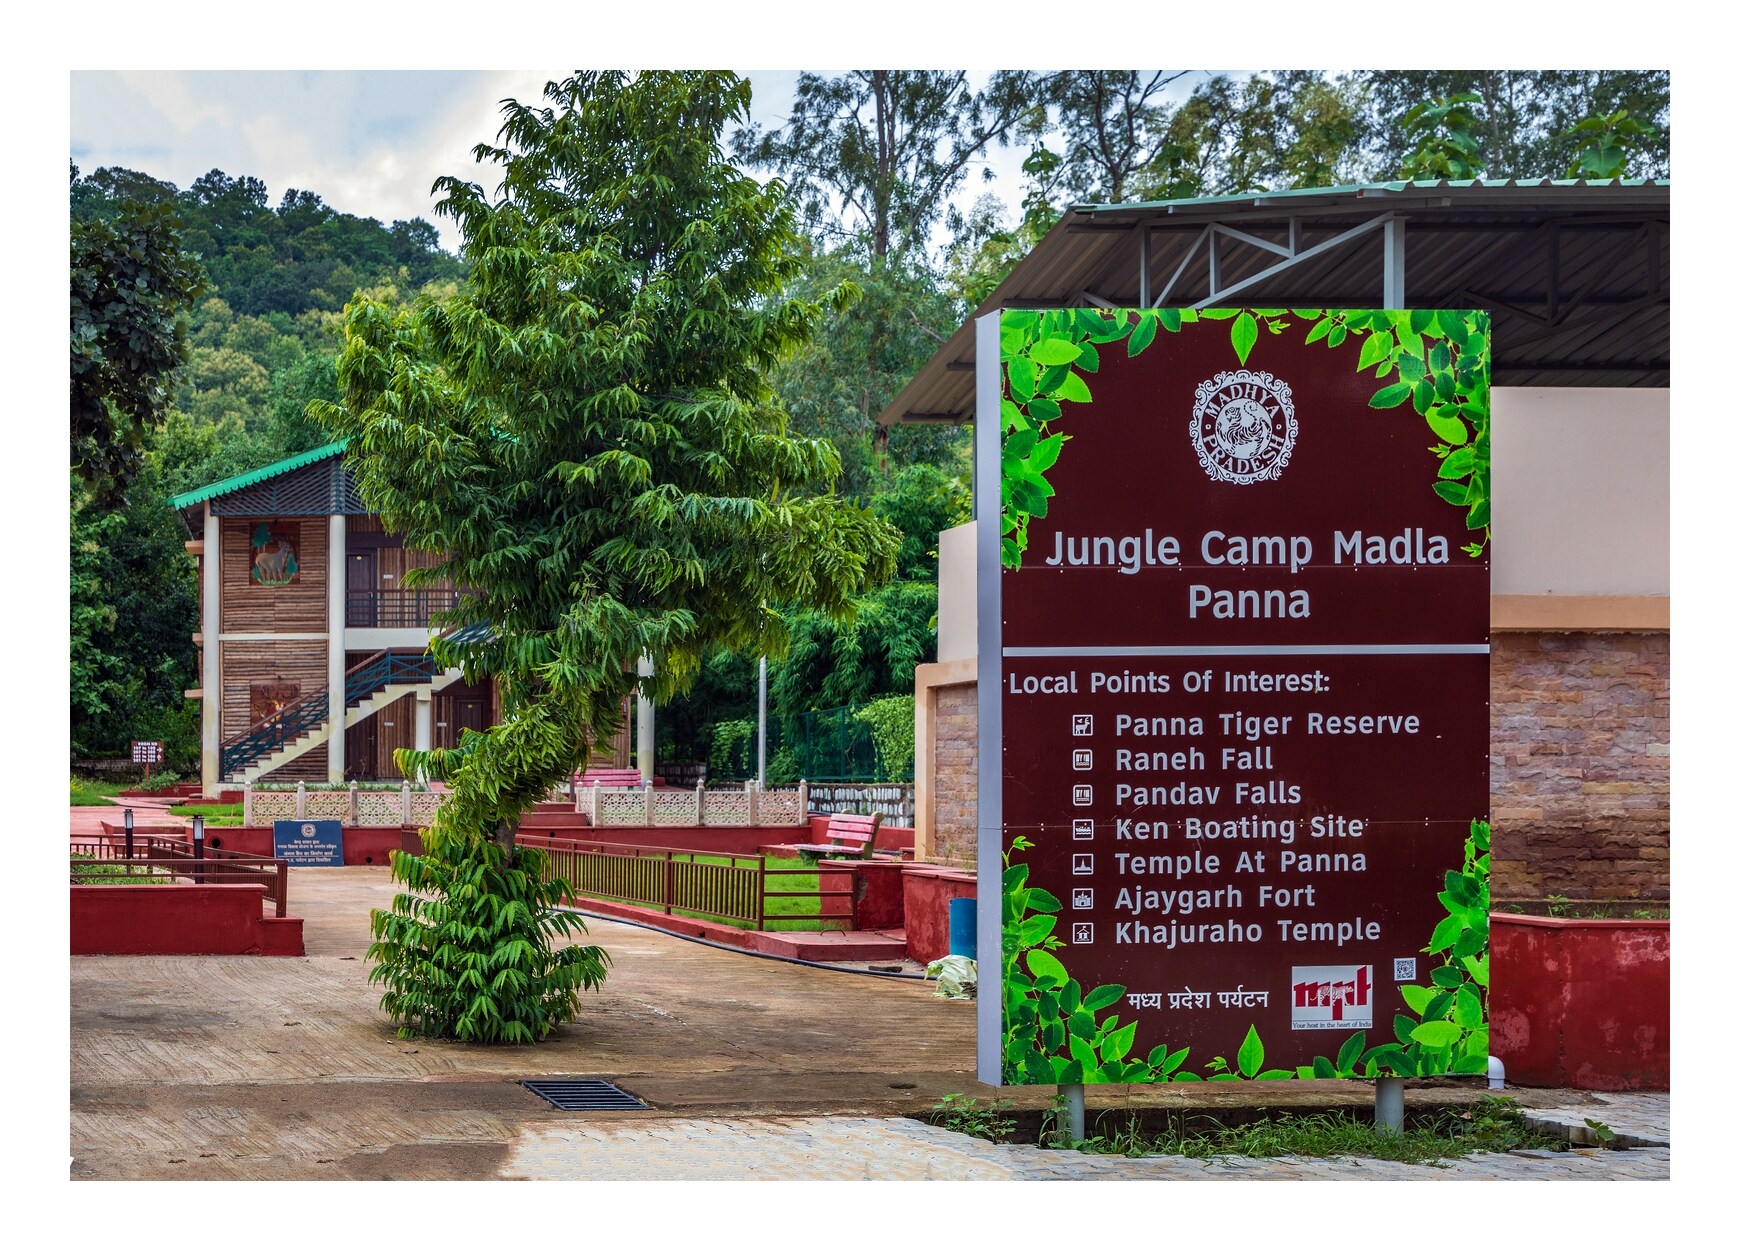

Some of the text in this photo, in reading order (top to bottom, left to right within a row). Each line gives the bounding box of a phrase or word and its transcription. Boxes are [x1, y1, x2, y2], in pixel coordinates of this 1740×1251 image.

[1205, 384, 1280, 419] MADHYA
[1203, 434, 1284, 474] PRADESH
[1045, 527, 1450, 575] Jungle Camp Madla
[1189, 584, 1311, 619] Panna
[1010, 670, 1330, 694] Local Points Of Interest:
[1116, 712, 1420, 741] Panna Tiger Reserve
[1116, 746, 1274, 771] Raneh Fall
[1116, 780, 1302, 806] Pandav Falls
[1116, 815, 1364, 844] Ken Boating Site
[1115, 850, 1367, 880] Temple At Panna
[1114, 884, 1316, 916] Ajaygarh Fort
[1116, 916, 1381, 950] Khajuraho Temple
[1127, 985, 1269, 1010] मध्य प्रदेश पर्यटन
